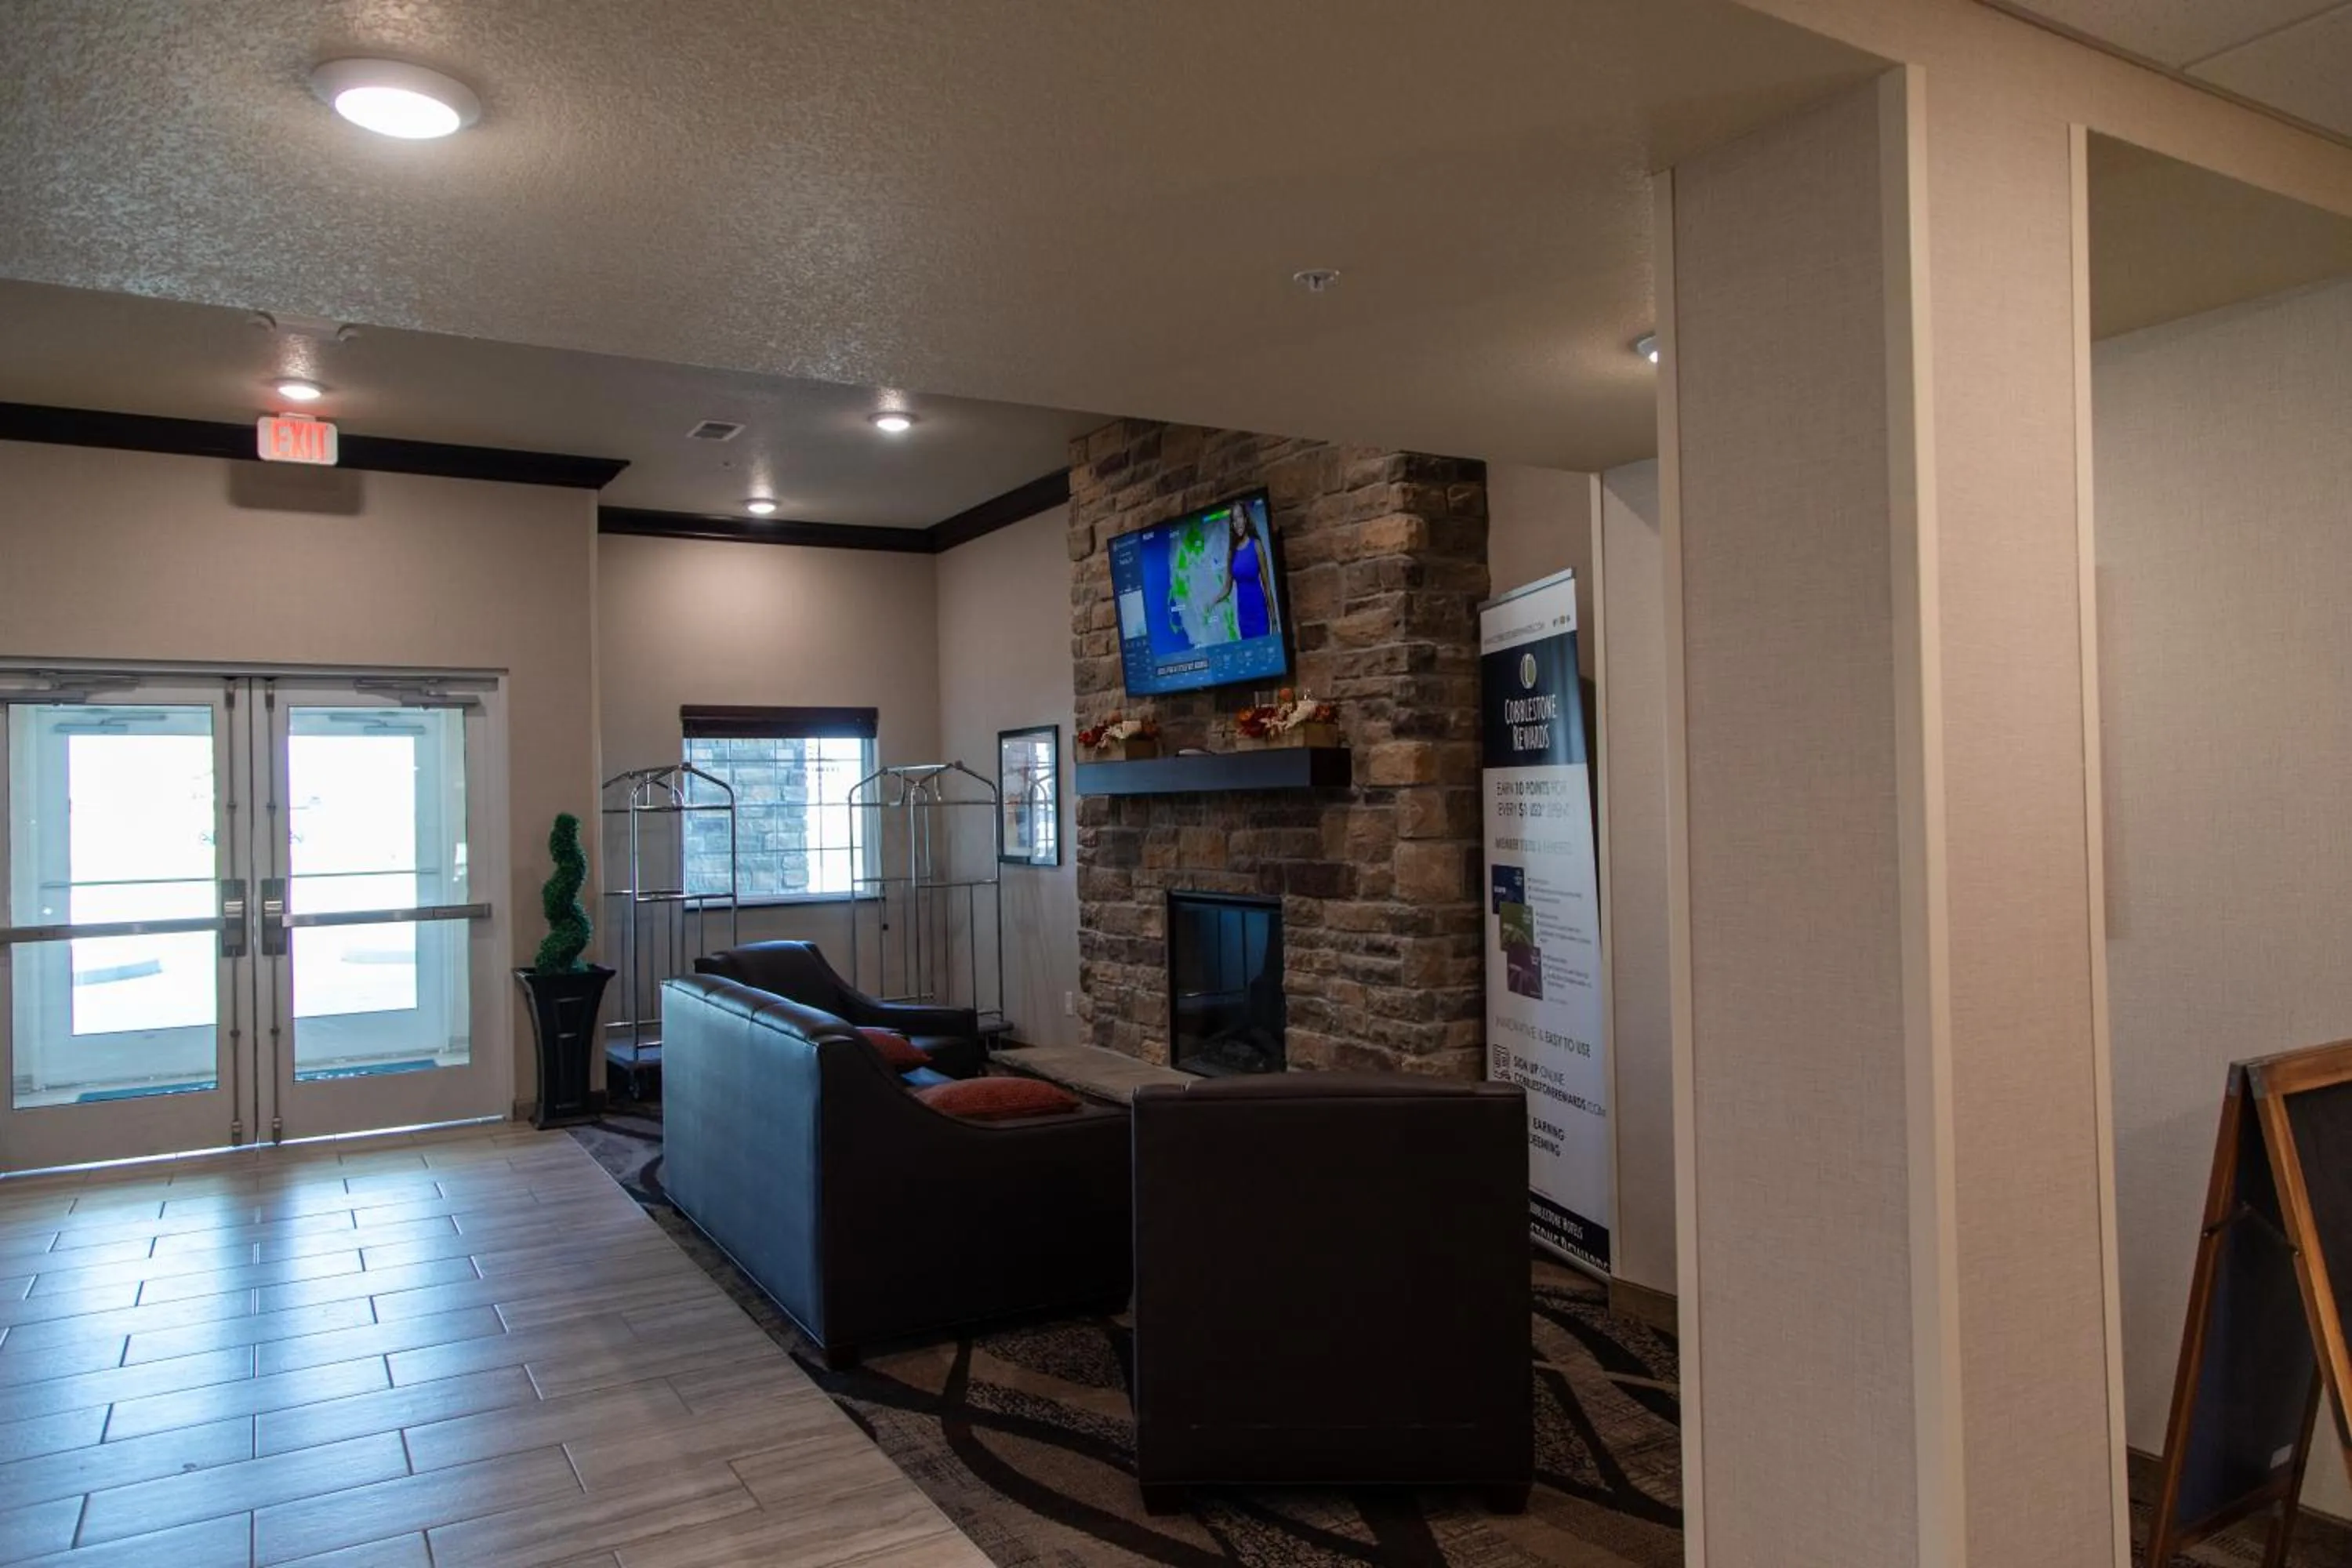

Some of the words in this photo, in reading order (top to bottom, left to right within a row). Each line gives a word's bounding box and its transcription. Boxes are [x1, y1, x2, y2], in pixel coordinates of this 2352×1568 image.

[271, 419, 328, 462] EXIT
[1504, 694, 1557, 724] COBBLESTONE
[1512, 724, 1550, 751] REWARDS
[1515, 780, 1525, 796] 10
[1526, 780, 1549, 796] POINTS
[1544, 1029, 1563, 1048] EASY
[1563, 1035, 1575, 1053] TO
[1576, 1040, 1591, 1059] USE
[1533, 1116, 1565, 1142] EARNING
